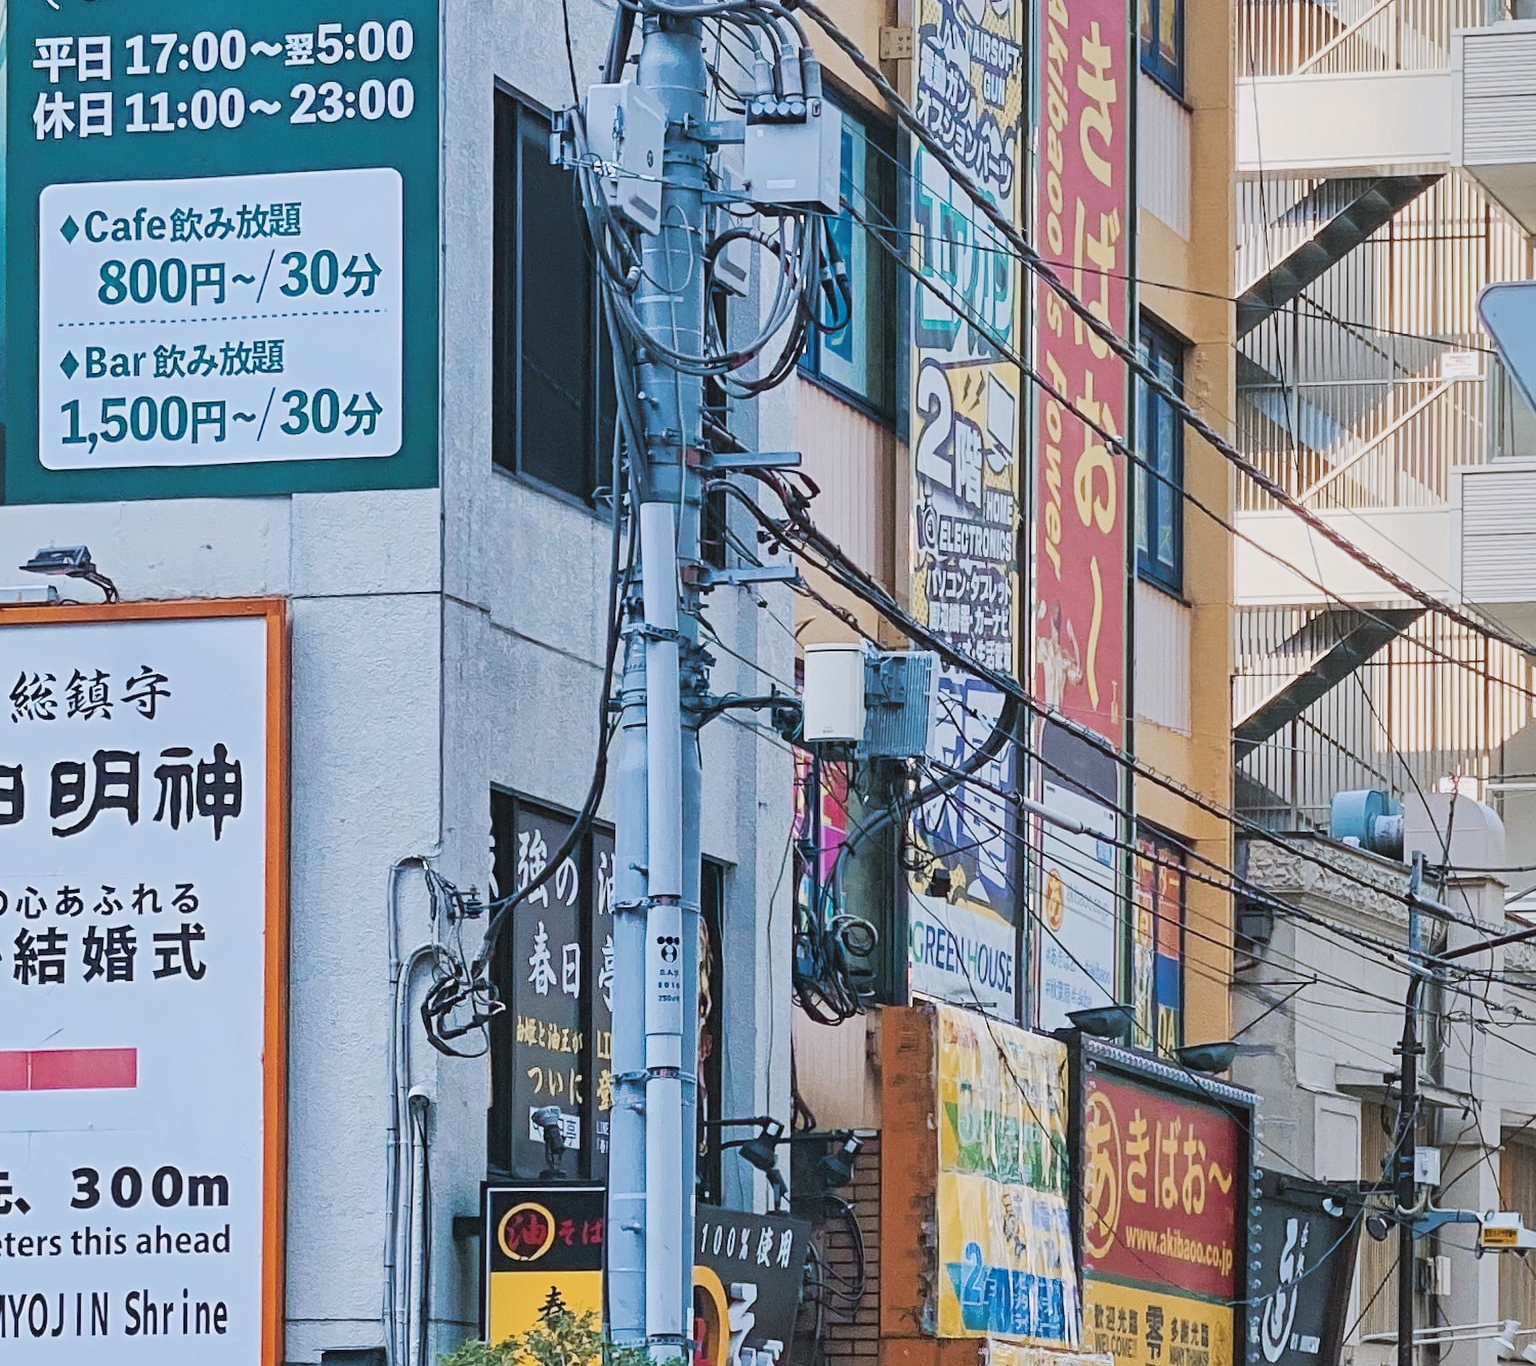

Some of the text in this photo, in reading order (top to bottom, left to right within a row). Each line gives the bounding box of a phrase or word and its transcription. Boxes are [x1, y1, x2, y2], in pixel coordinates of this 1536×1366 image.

[32, 36, 112, 85] 平日
[972, 32, 1022, 75] AIRSOFT
[983, 71, 1007, 109] GUN
[32, 93, 113, 141] 休日
[986, 490, 1015, 525] HOME
[939, 519, 1013, 563] ELECTRONICS
[9, 665, 173, 722] 総鎮守
[0, 743, 243, 841] 明神
[0, 882, 201, 919] 心あふれる
[0, 923, 208, 986] 結婚式
[526, 1066, 584, 1106] ついに
[70, 1165, 231, 1210] 300m
[70, 1226, 128, 1257] this
[136, 1223, 232, 1255] ahead
[1125, 1223, 1234, 1277] www.akibaoo.co.jp
[124, 1287, 229, 1338] Shrine
